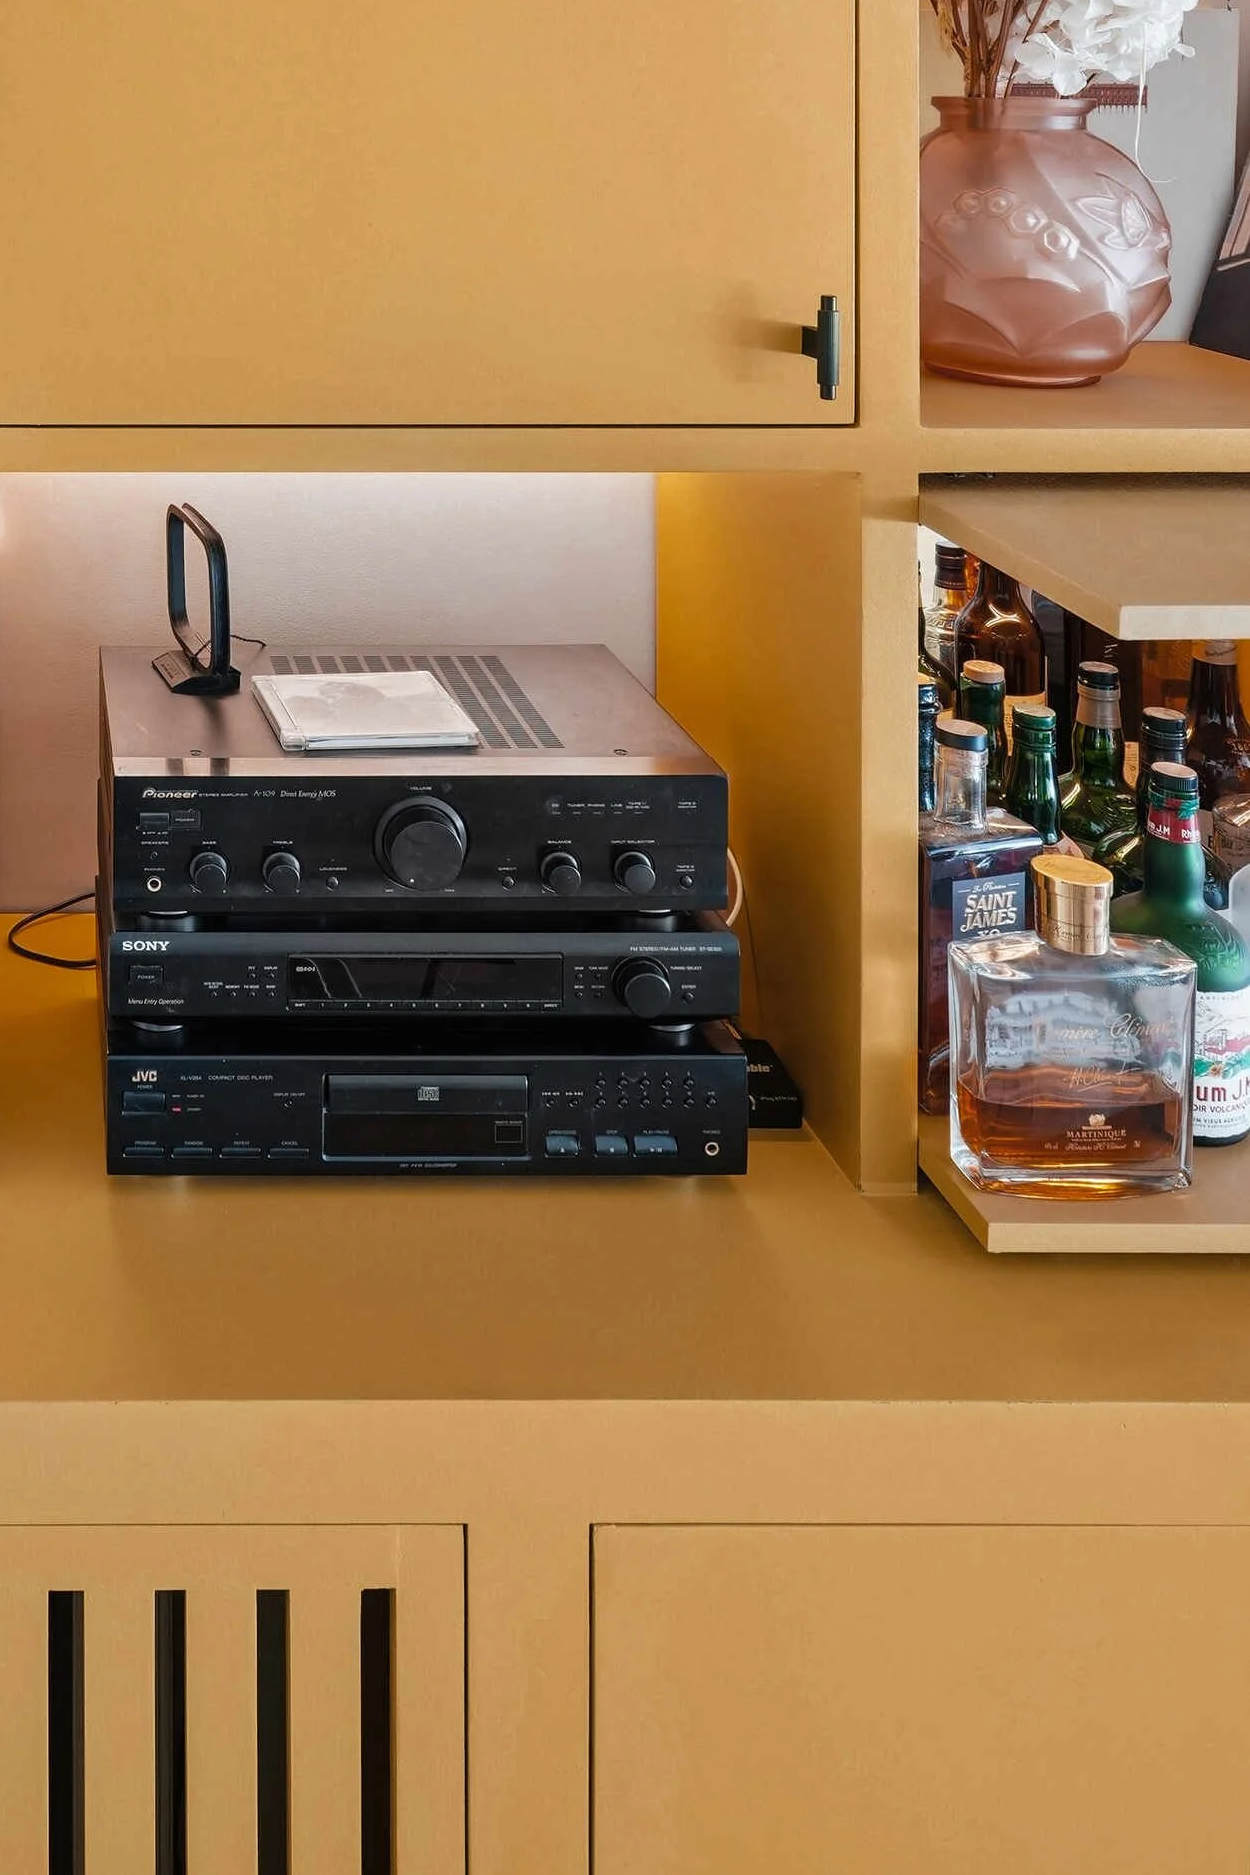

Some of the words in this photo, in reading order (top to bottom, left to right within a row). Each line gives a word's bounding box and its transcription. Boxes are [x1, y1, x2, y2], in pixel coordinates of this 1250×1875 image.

[141, 787, 199, 799] Pioneer
[316, 790, 336, 800] MOS
[966, 891, 1017, 913] SAINT
[960, 908, 1017, 933] JAMES
[122, 940, 171, 952] SONY
[143, 998, 158, 1006] Entry
[158, 998, 184, 1006] Operation
[131, 1070, 158, 1082] JVC
[1066, 1129, 1127, 1138] MARTINIQUE
